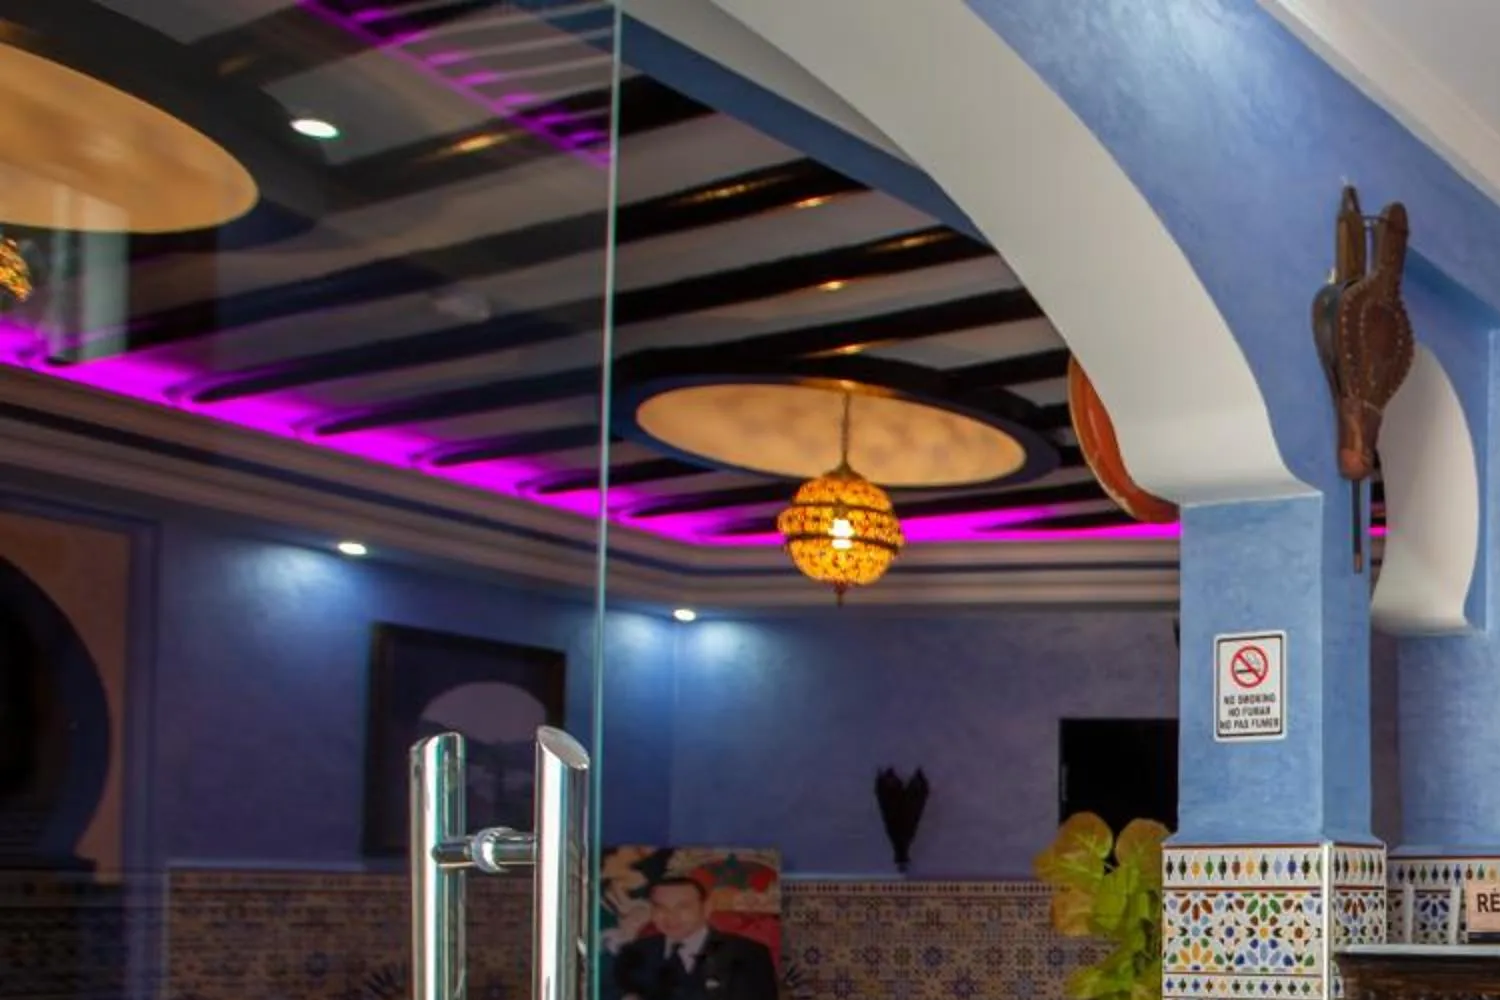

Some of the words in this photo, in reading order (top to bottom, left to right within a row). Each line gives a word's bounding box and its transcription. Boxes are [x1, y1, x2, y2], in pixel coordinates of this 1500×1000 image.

[1224, 694, 1235, 704] NO
[1238, 692, 1276, 704] SMOKING
[1228, 707, 1240, 717] NO
[1234, 719, 1249, 728] PAS
